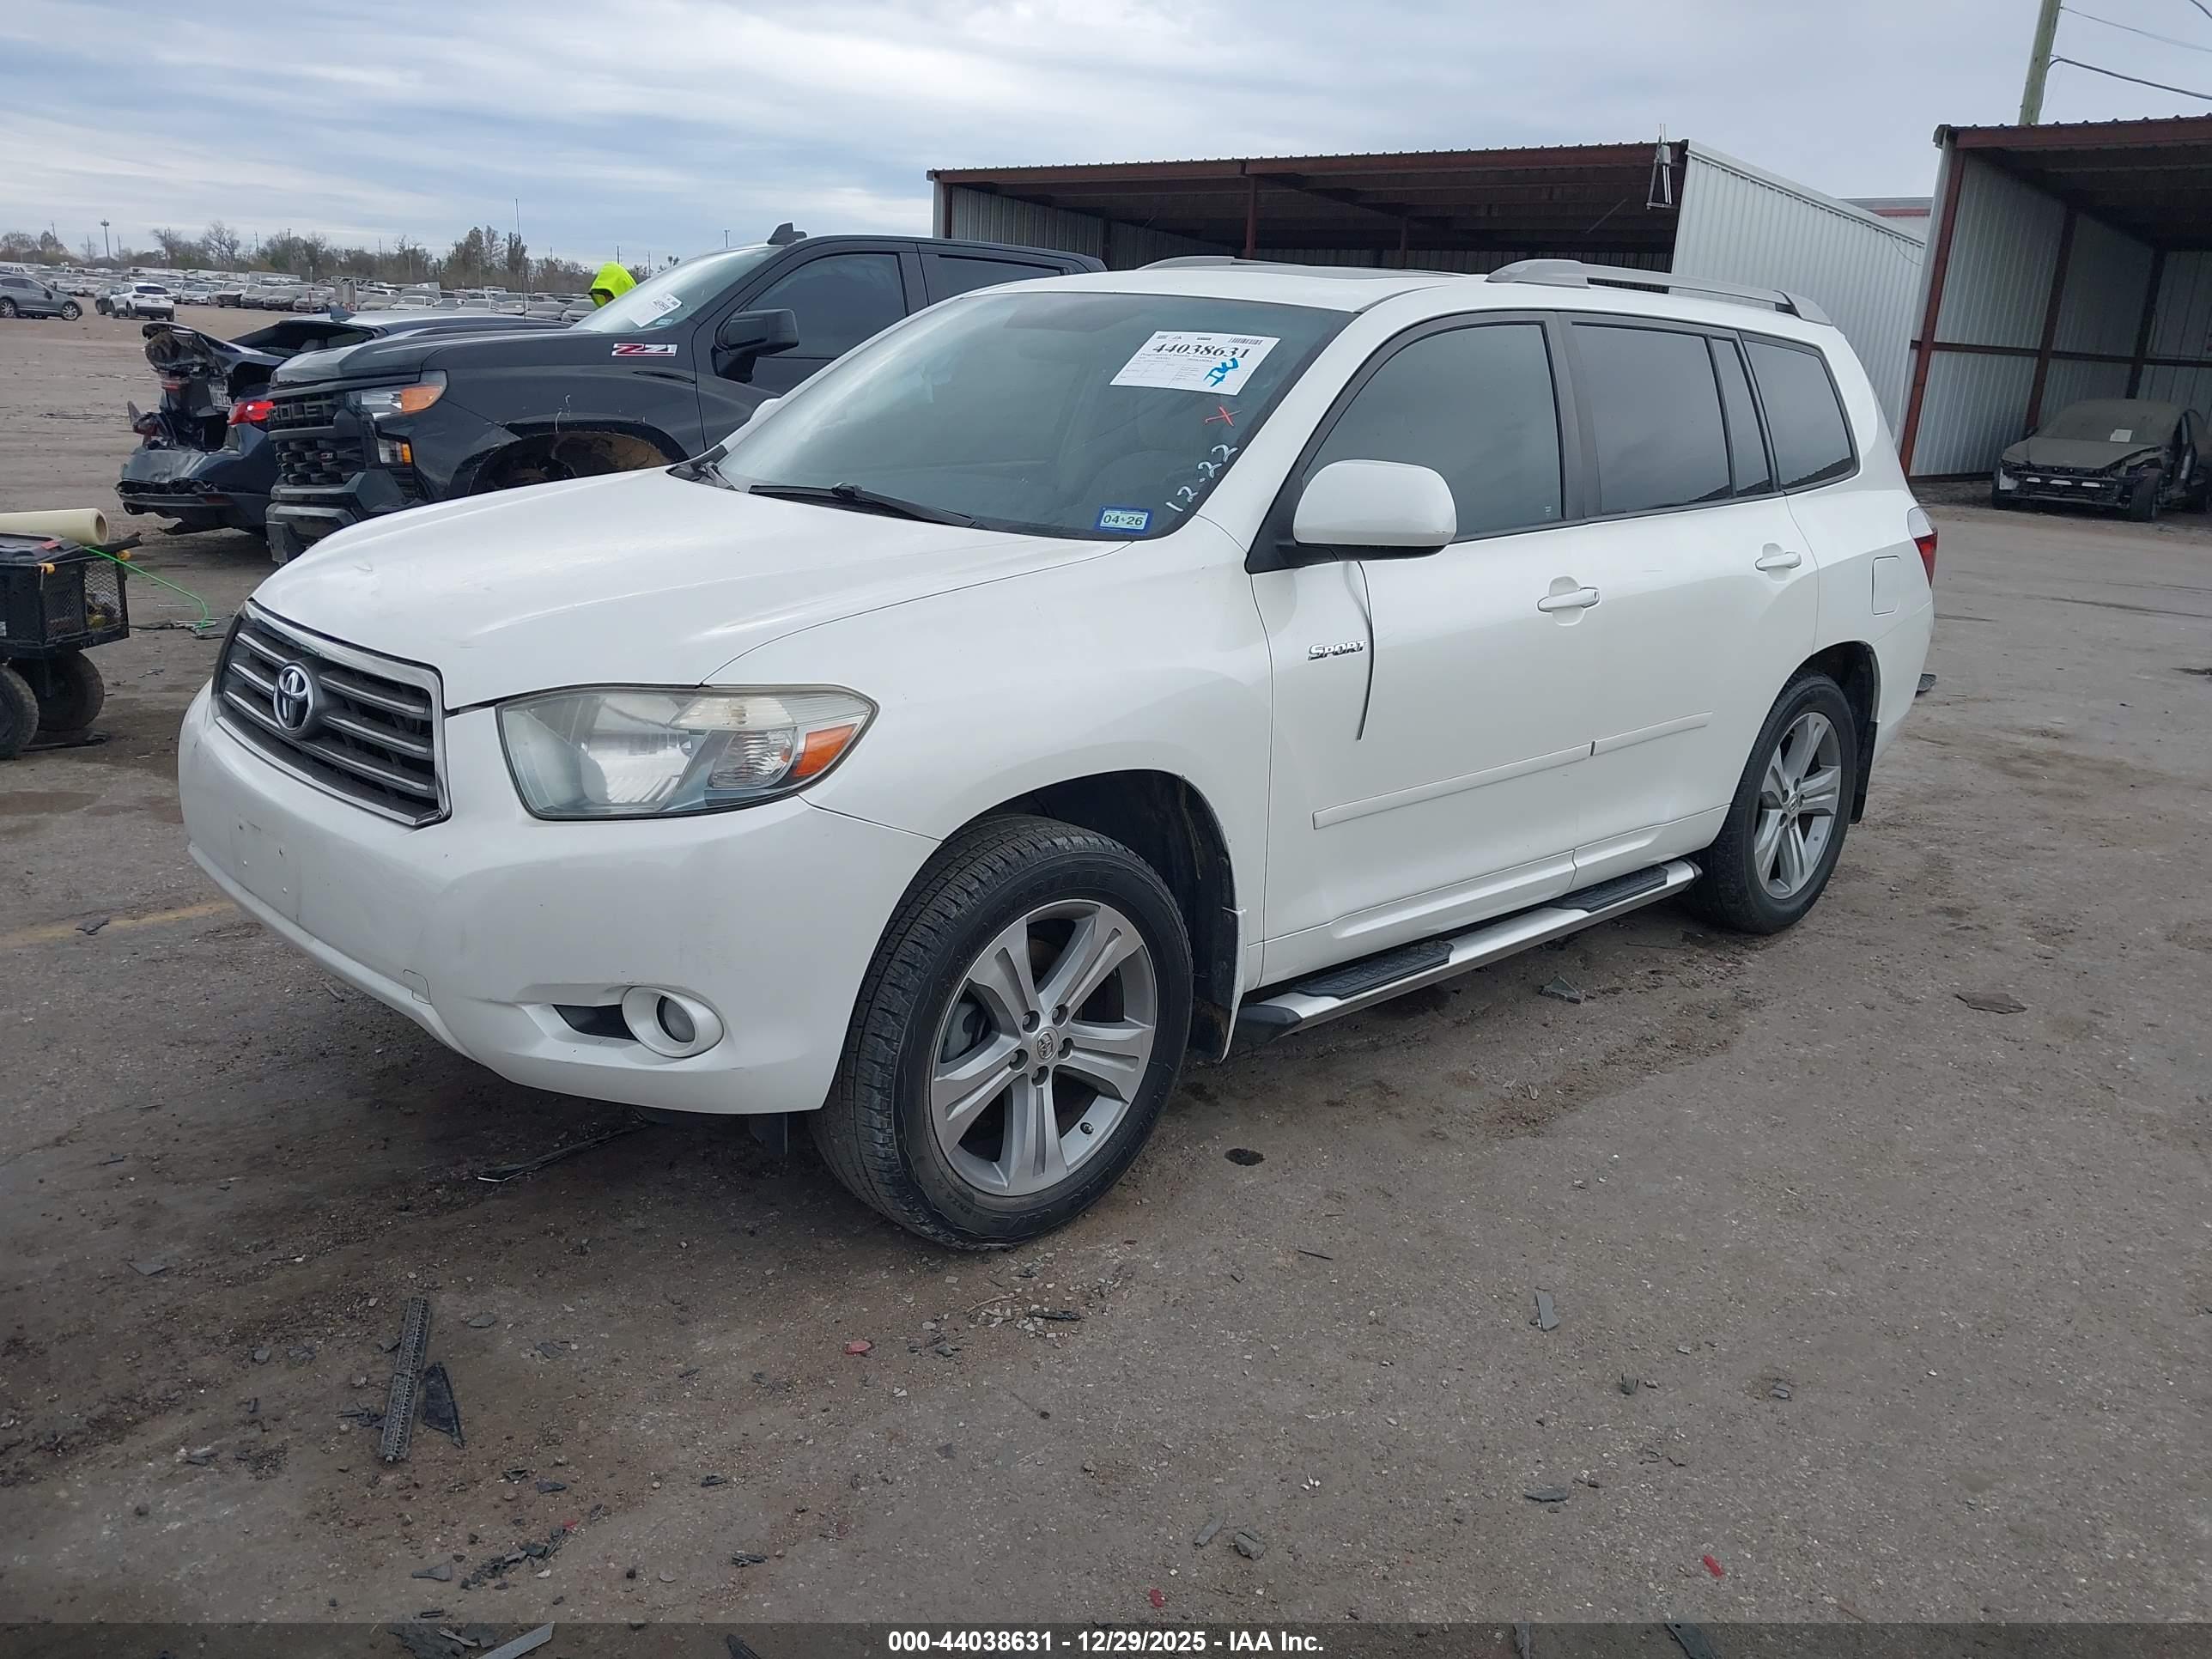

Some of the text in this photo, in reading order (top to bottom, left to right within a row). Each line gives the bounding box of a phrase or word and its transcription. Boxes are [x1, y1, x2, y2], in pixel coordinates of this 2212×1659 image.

[611, 343, 678, 356] Z71
[1152, 343, 1251, 359] 44038631
[1308, 640, 1367, 660] SPORT
